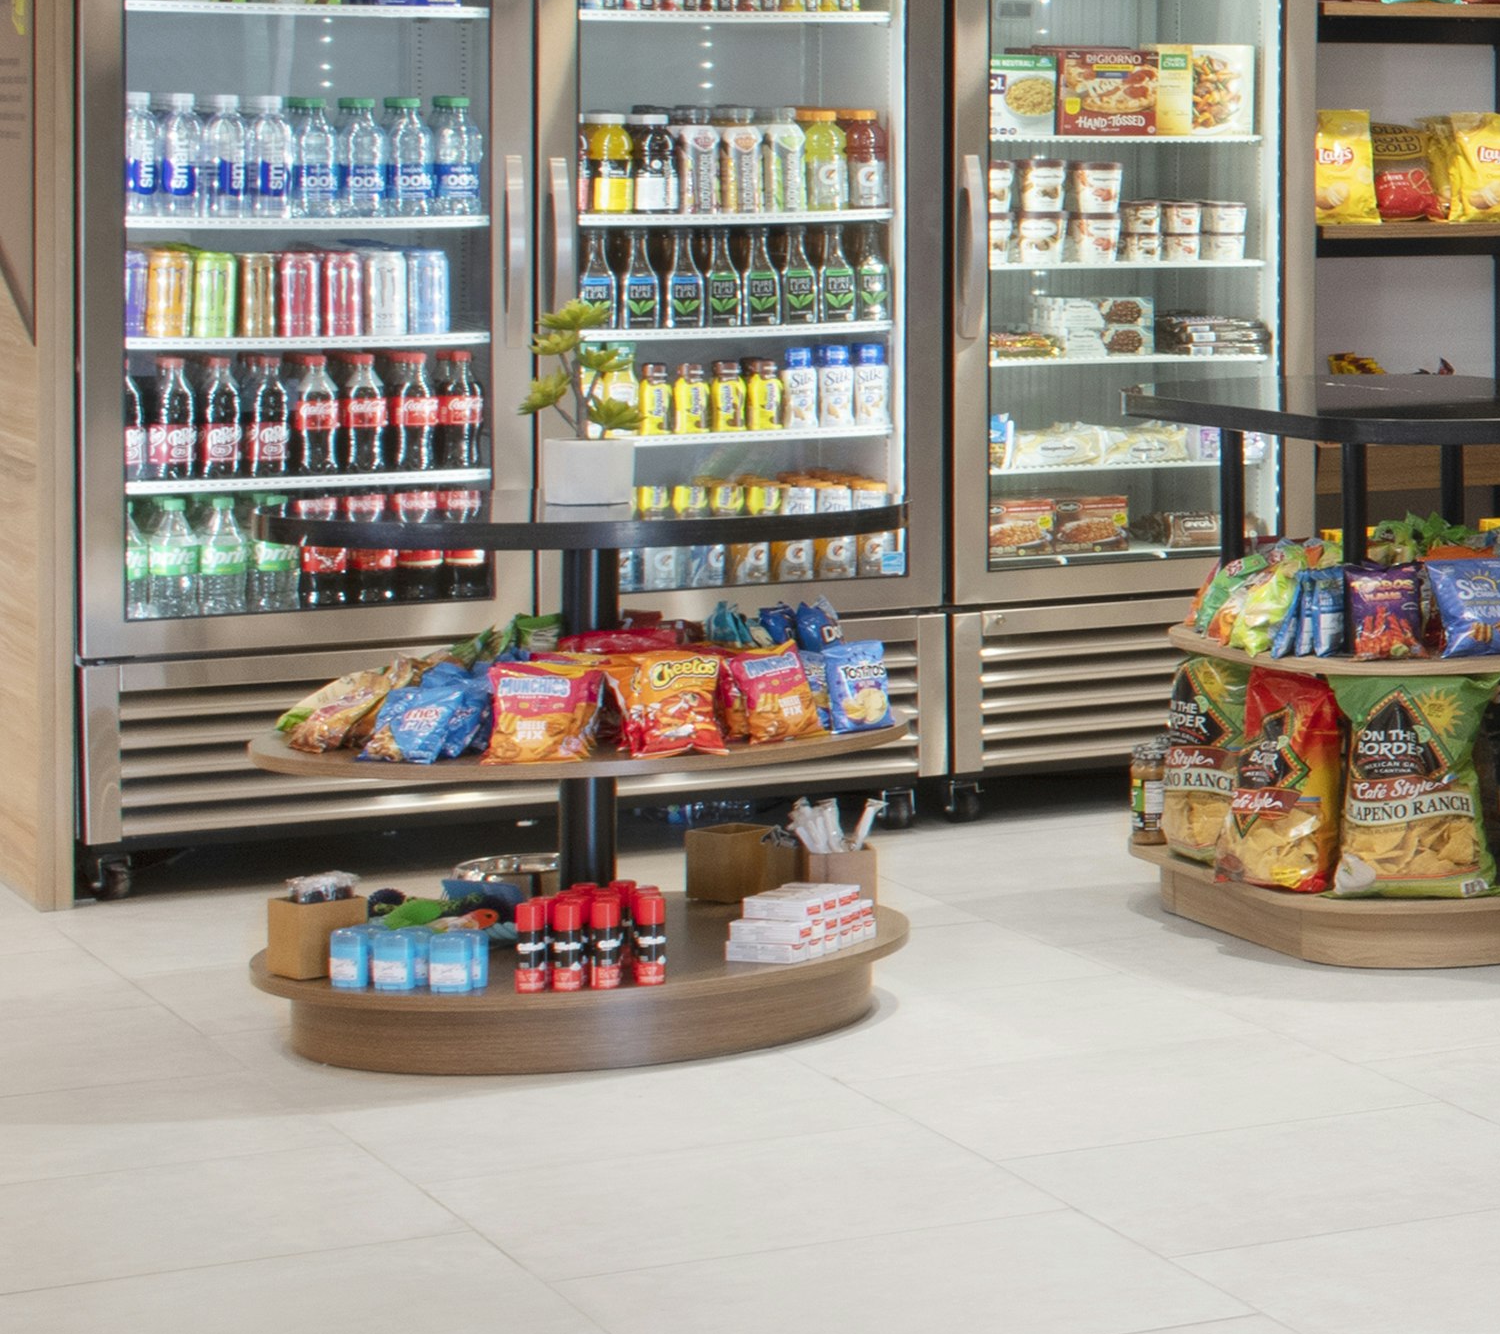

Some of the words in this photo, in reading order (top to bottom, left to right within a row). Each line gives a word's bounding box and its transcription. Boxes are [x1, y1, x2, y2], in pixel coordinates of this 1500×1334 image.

[1374, 143, 1418, 154] GOLD
[652, 658, 718, 687] Cheetos
[1178, 700, 1198, 715] THE
[516, 729, 544, 742] FIX
[1361, 730, 1385, 742] ON
[1388, 729, 1416, 743] THE
[1354, 782, 1388, 799] Café
[1390, 778, 1438, 800] Style
[1412, 795, 1471, 816] RANCH
